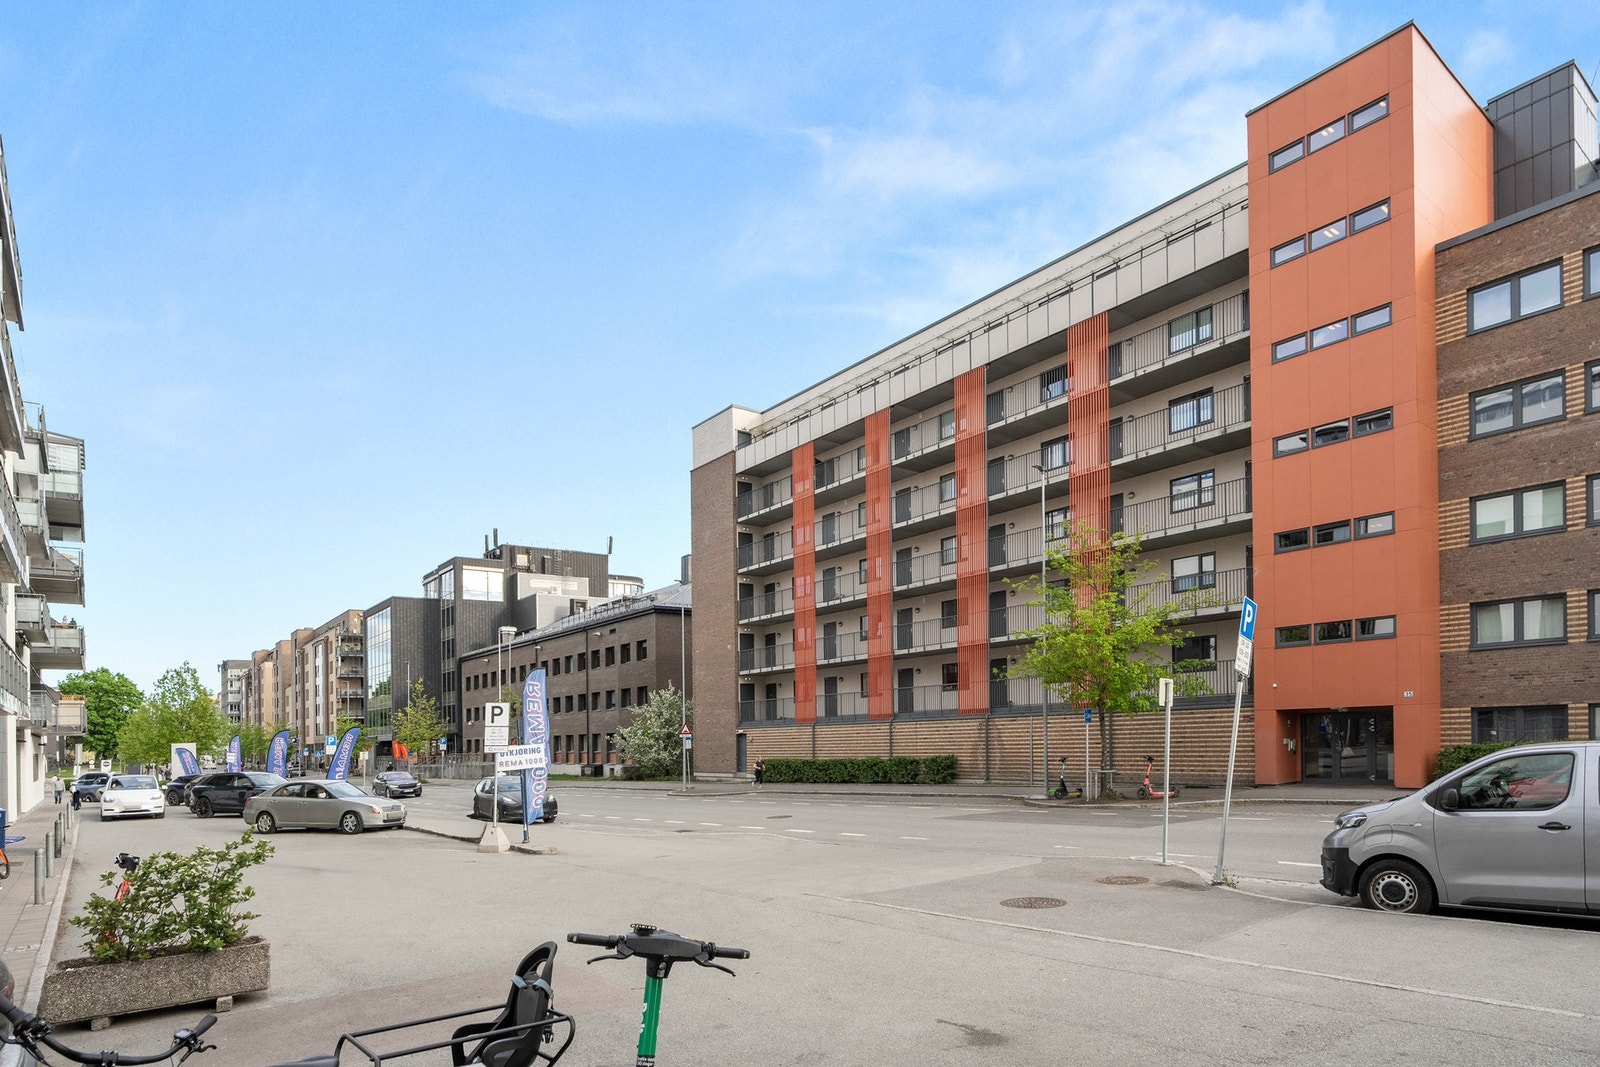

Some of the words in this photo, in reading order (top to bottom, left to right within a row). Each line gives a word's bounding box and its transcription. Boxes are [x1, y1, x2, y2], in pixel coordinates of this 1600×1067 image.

[1243, 604, 1253, 632] P
[491, 705, 503, 723] P
[499, 760, 523, 768] REMA
[525, 757, 543, 766] 1000
